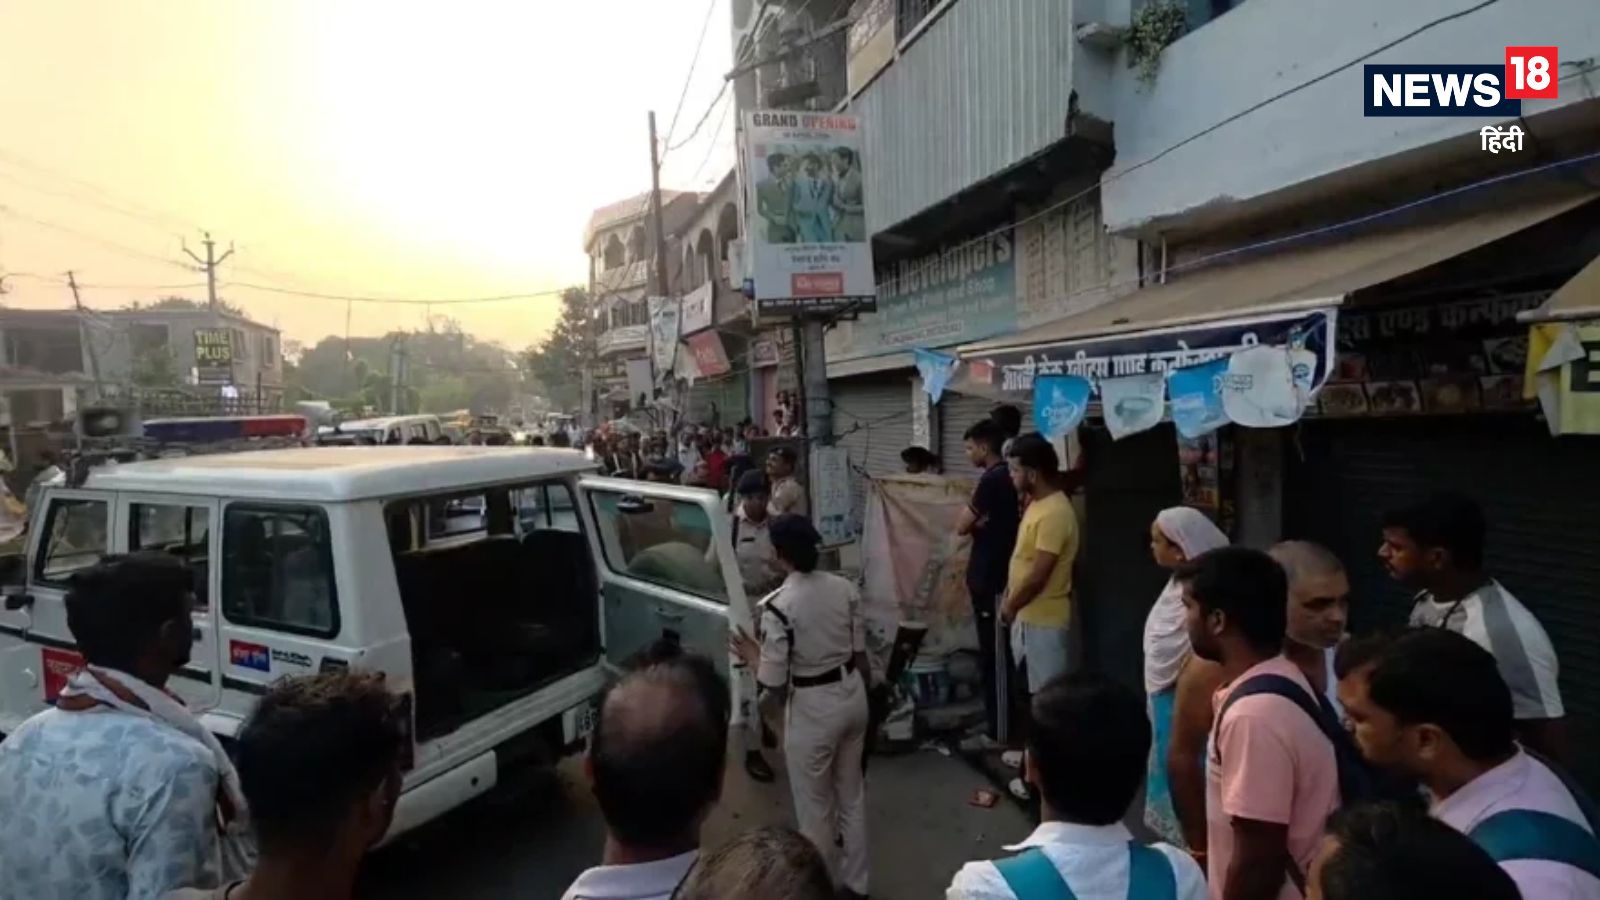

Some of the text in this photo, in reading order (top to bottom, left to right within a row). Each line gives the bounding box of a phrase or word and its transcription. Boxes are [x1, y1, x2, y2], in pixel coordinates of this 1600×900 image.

[752, 113, 857, 130] GRAND OPENING
[194, 330, 229, 345] TIME
[196, 346, 230, 360] PLUS
